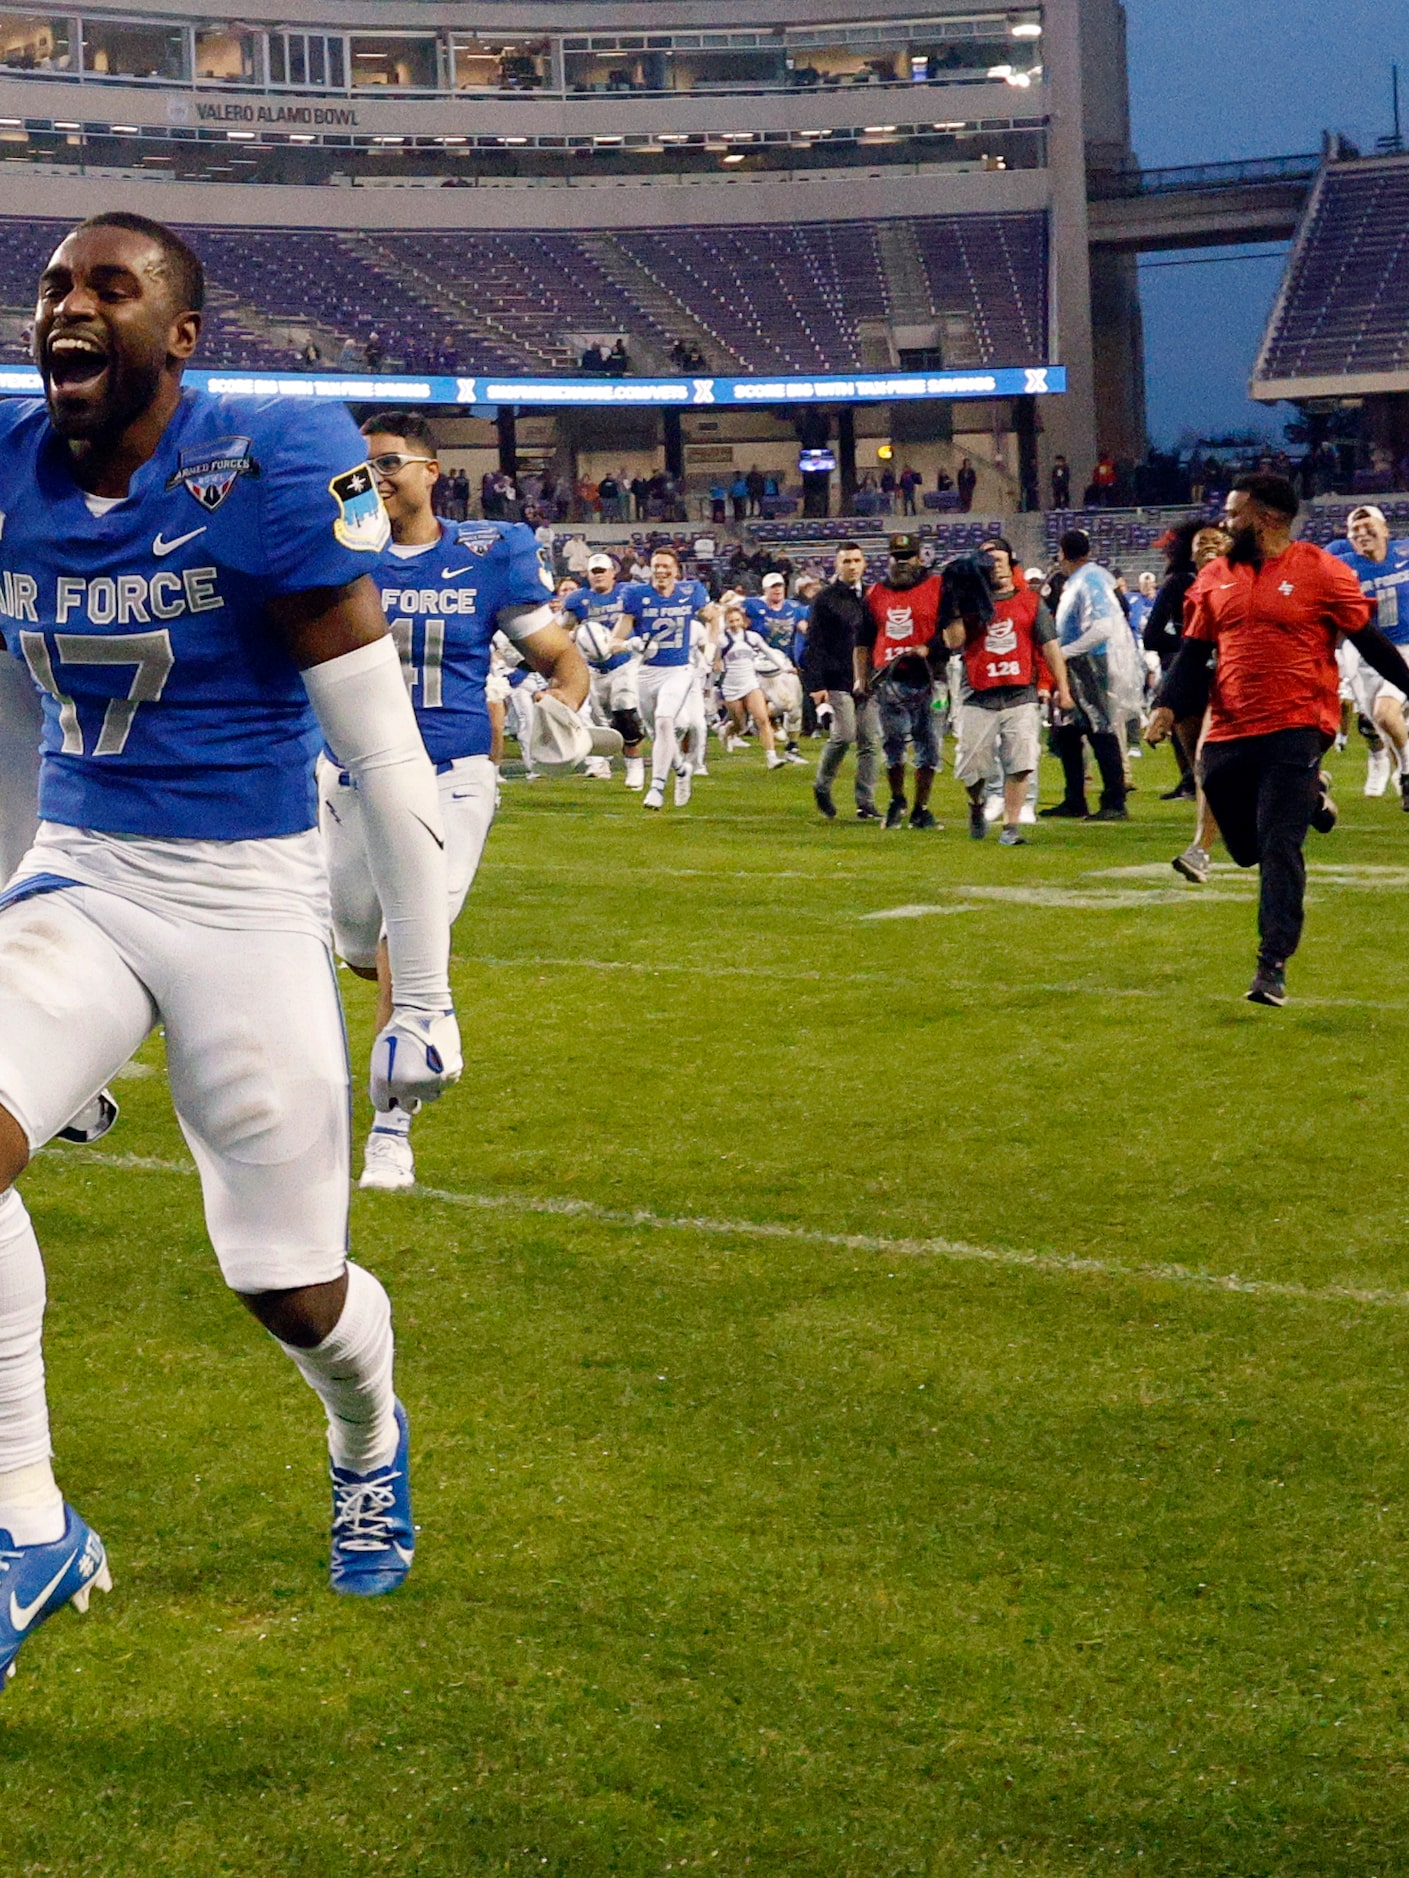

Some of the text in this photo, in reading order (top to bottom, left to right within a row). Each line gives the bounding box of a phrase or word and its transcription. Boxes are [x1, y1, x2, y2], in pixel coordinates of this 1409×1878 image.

[195, 102, 253, 121] VALERO
[257, 105, 311, 124] ALAMO
[314, 108, 360, 127] BOWL
[55, 566, 225, 625] FORCE
[381, 588, 478, 615] FORCE
[986, 660, 1021, 678] 128
[19, 628, 176, 757] 17
